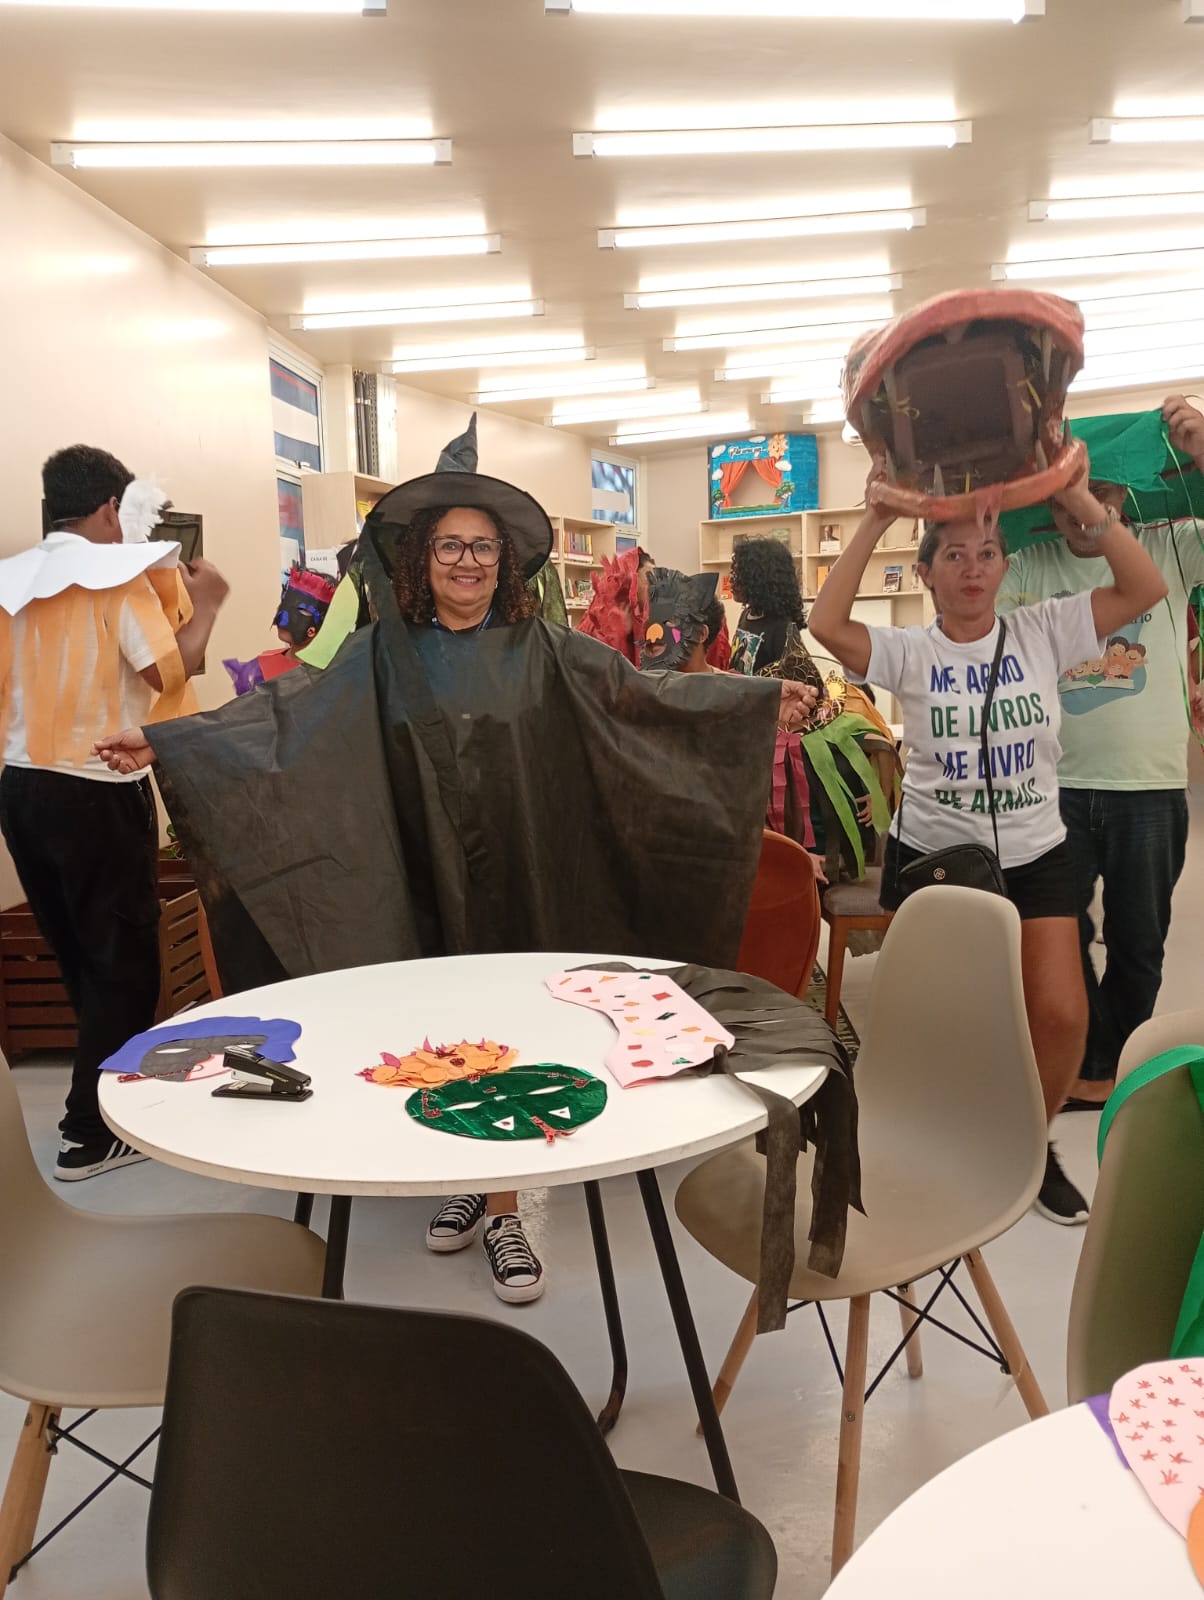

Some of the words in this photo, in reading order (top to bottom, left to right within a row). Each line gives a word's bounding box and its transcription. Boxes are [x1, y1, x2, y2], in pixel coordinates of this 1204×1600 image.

[930, 664, 961, 695] ME
[930, 705, 960, 738] DE
[968, 692, 1050, 737] LVROS,
[934, 750, 969, 780] ME
[978, 738, 1035, 780] LIVRO
